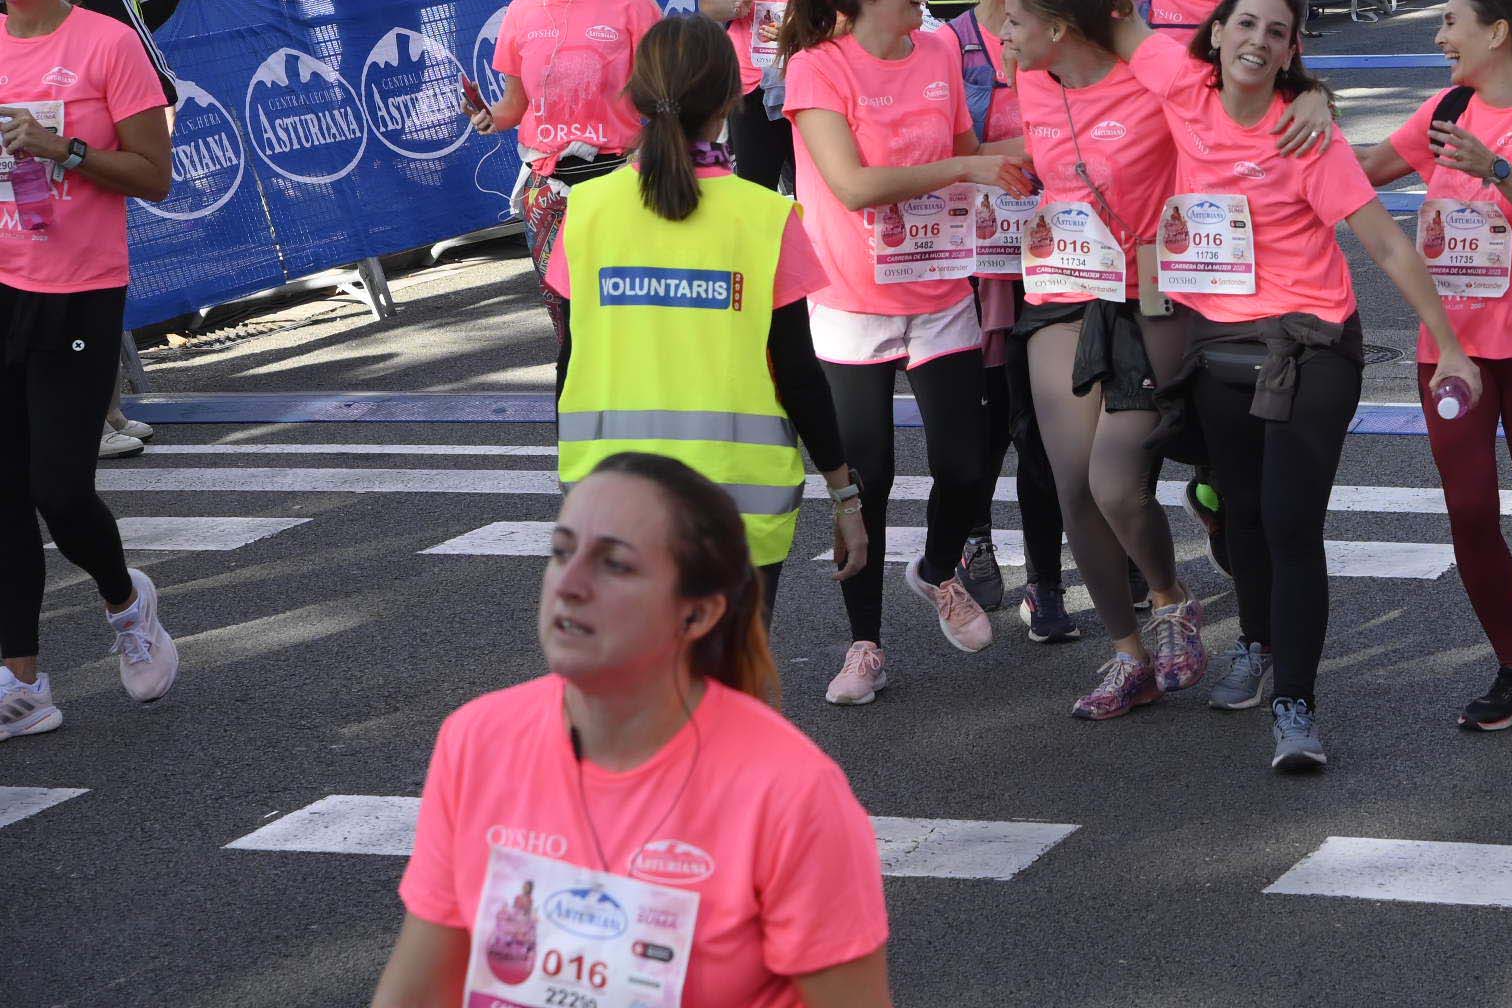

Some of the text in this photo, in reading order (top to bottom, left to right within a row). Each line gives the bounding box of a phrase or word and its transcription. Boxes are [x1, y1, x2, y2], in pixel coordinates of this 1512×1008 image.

[1153, 7, 1183, 22] YSHO
[527, 28, 560, 40] OYSHO
[257, 103, 362, 155] ASTURIANA
[536, 123, 609, 143] ORSAL
[909, 222, 941, 238] 016
[914, 241, 934, 250] 5482
[1057, 239, 1091, 253] 016
[1192, 232, 1223, 246] 016
[1447, 237, 1480, 251] 016
[1060, 257, 1087, 267] 11734
[1196, 251, 1219, 260] 11736
[1449, 255, 1474, 264] 11735
[884, 268, 914, 278] OYSHO
[601, 276, 728, 300] VOLUNTARIS
[733, 273, 742, 311] 2000
[485, 824, 569, 856] OYSHO
[542, 949, 609, 990] 016
